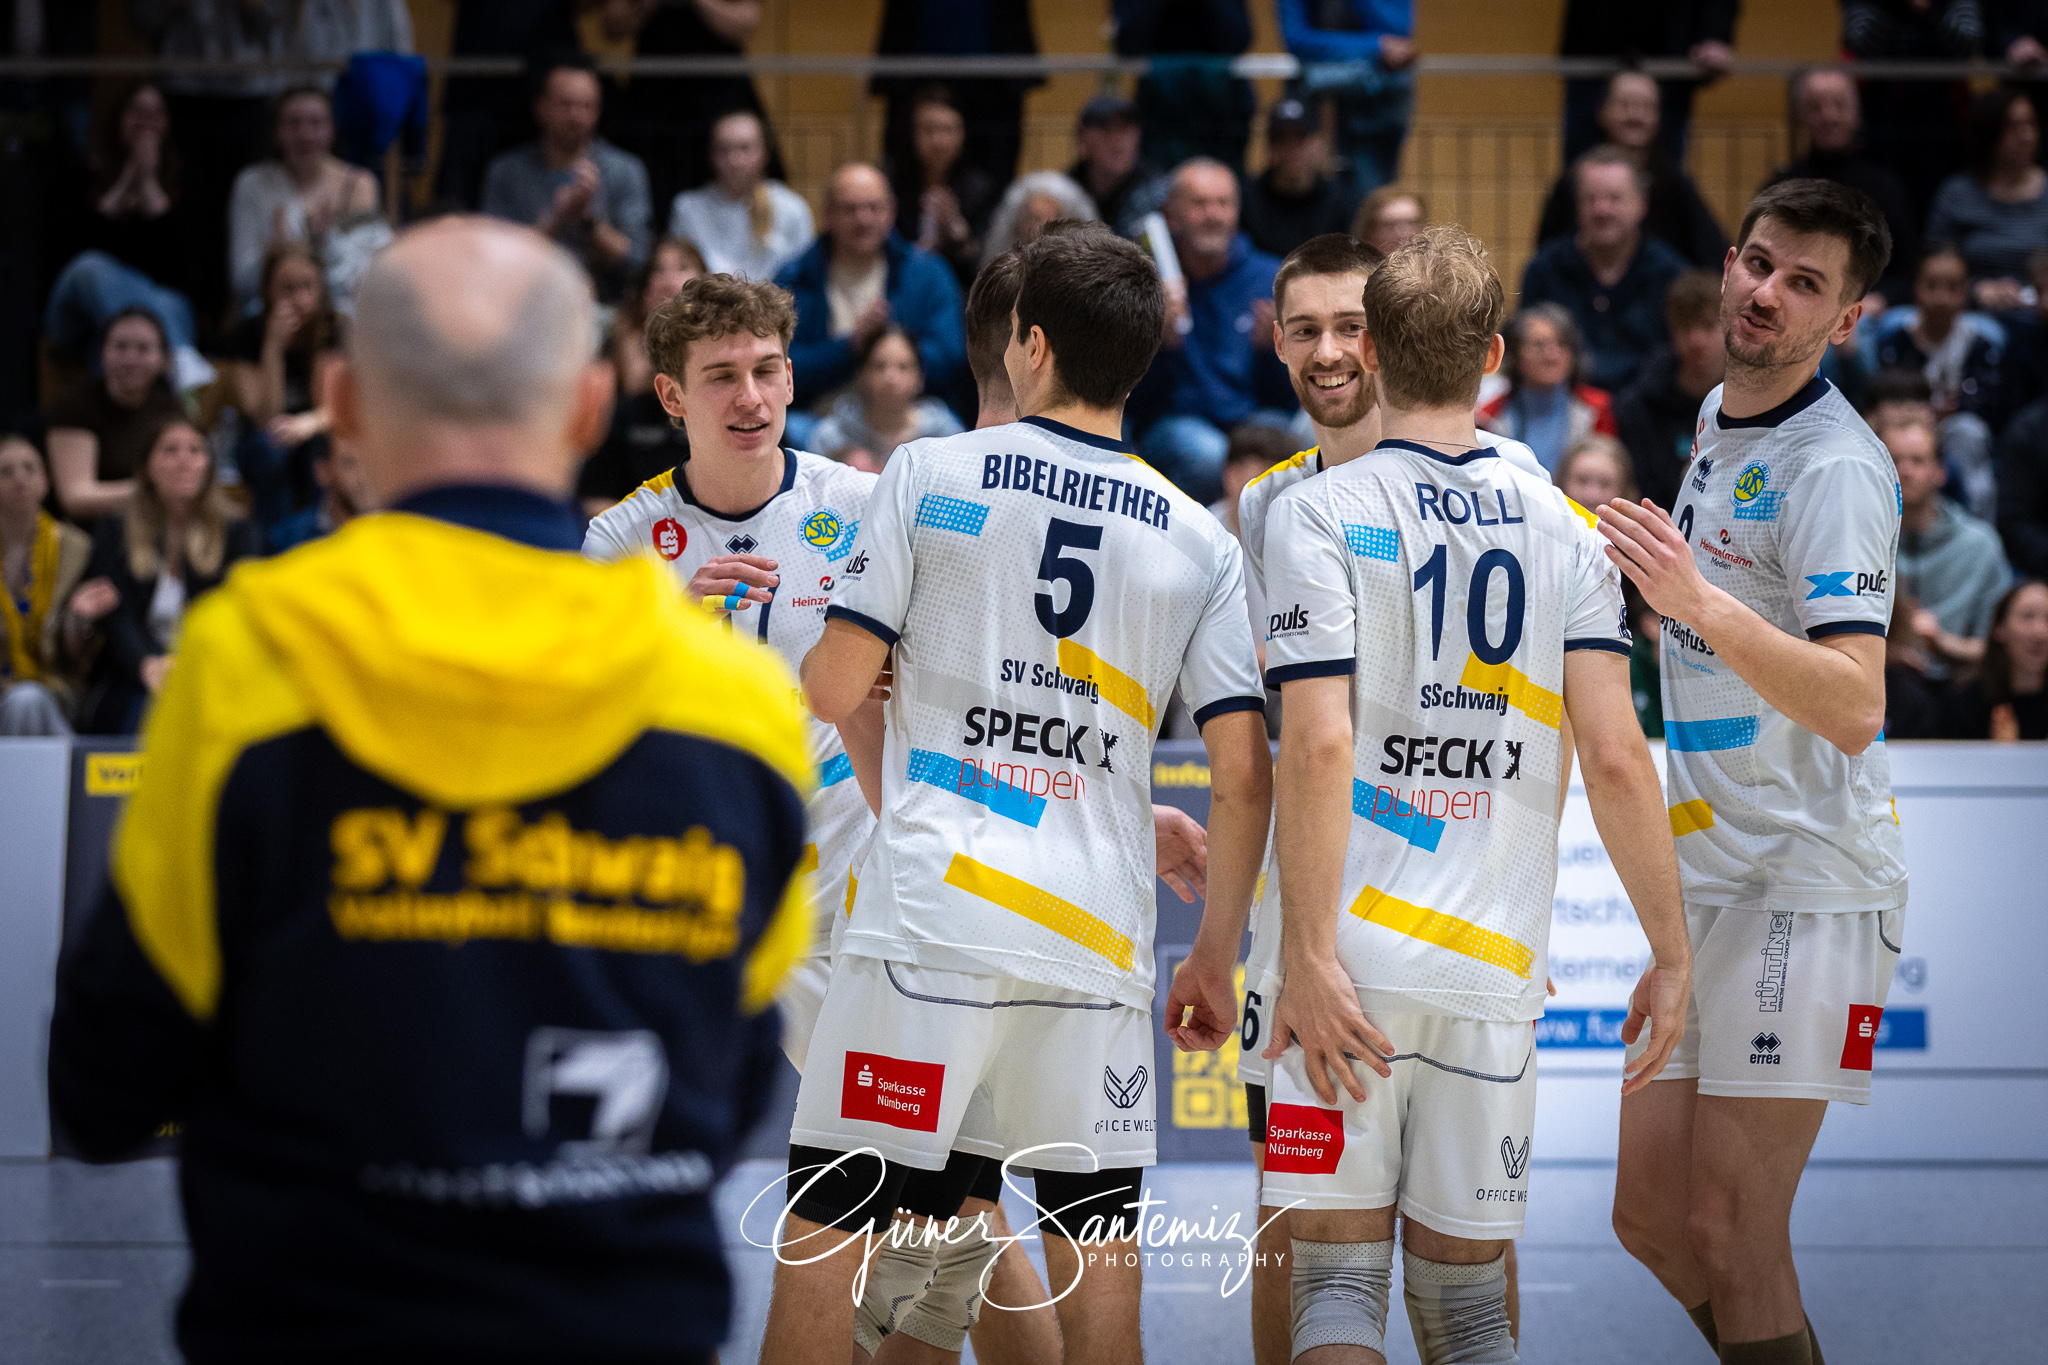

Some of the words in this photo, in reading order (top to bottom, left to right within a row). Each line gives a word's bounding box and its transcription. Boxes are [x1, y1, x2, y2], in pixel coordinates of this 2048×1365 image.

[981, 453, 1171, 531] BIBELRIETHER
[1414, 482, 1524, 526] ROLL
[845, 549, 870, 574] uls
[1699, 537, 1753, 569] Heinzelmann
[1710, 556, 1732, 571] Medien
[1034, 517, 1104, 640] 5
[792, 595, 830, 608] Heinze
[1413, 544, 1526, 666] 10
[1269, 603, 1309, 640] puls
[1000, 659, 1026, 684] SV
[1031, 663, 1098, 705] Schwaig
[963, 706, 1090, 766] SPECK
[957, 758, 1087, 804] pumpen
[1241, 990, 1262, 1051] 6
[1749, 1053, 1781, 1065] errea
[877, 1077, 926, 1097] Sparkasse
[1269, 1125, 1332, 1142] Sparkasse
[1268, 1142, 1324, 1160] Nürnberg
[1476, 1188, 1527, 1202] OFFICEWE
